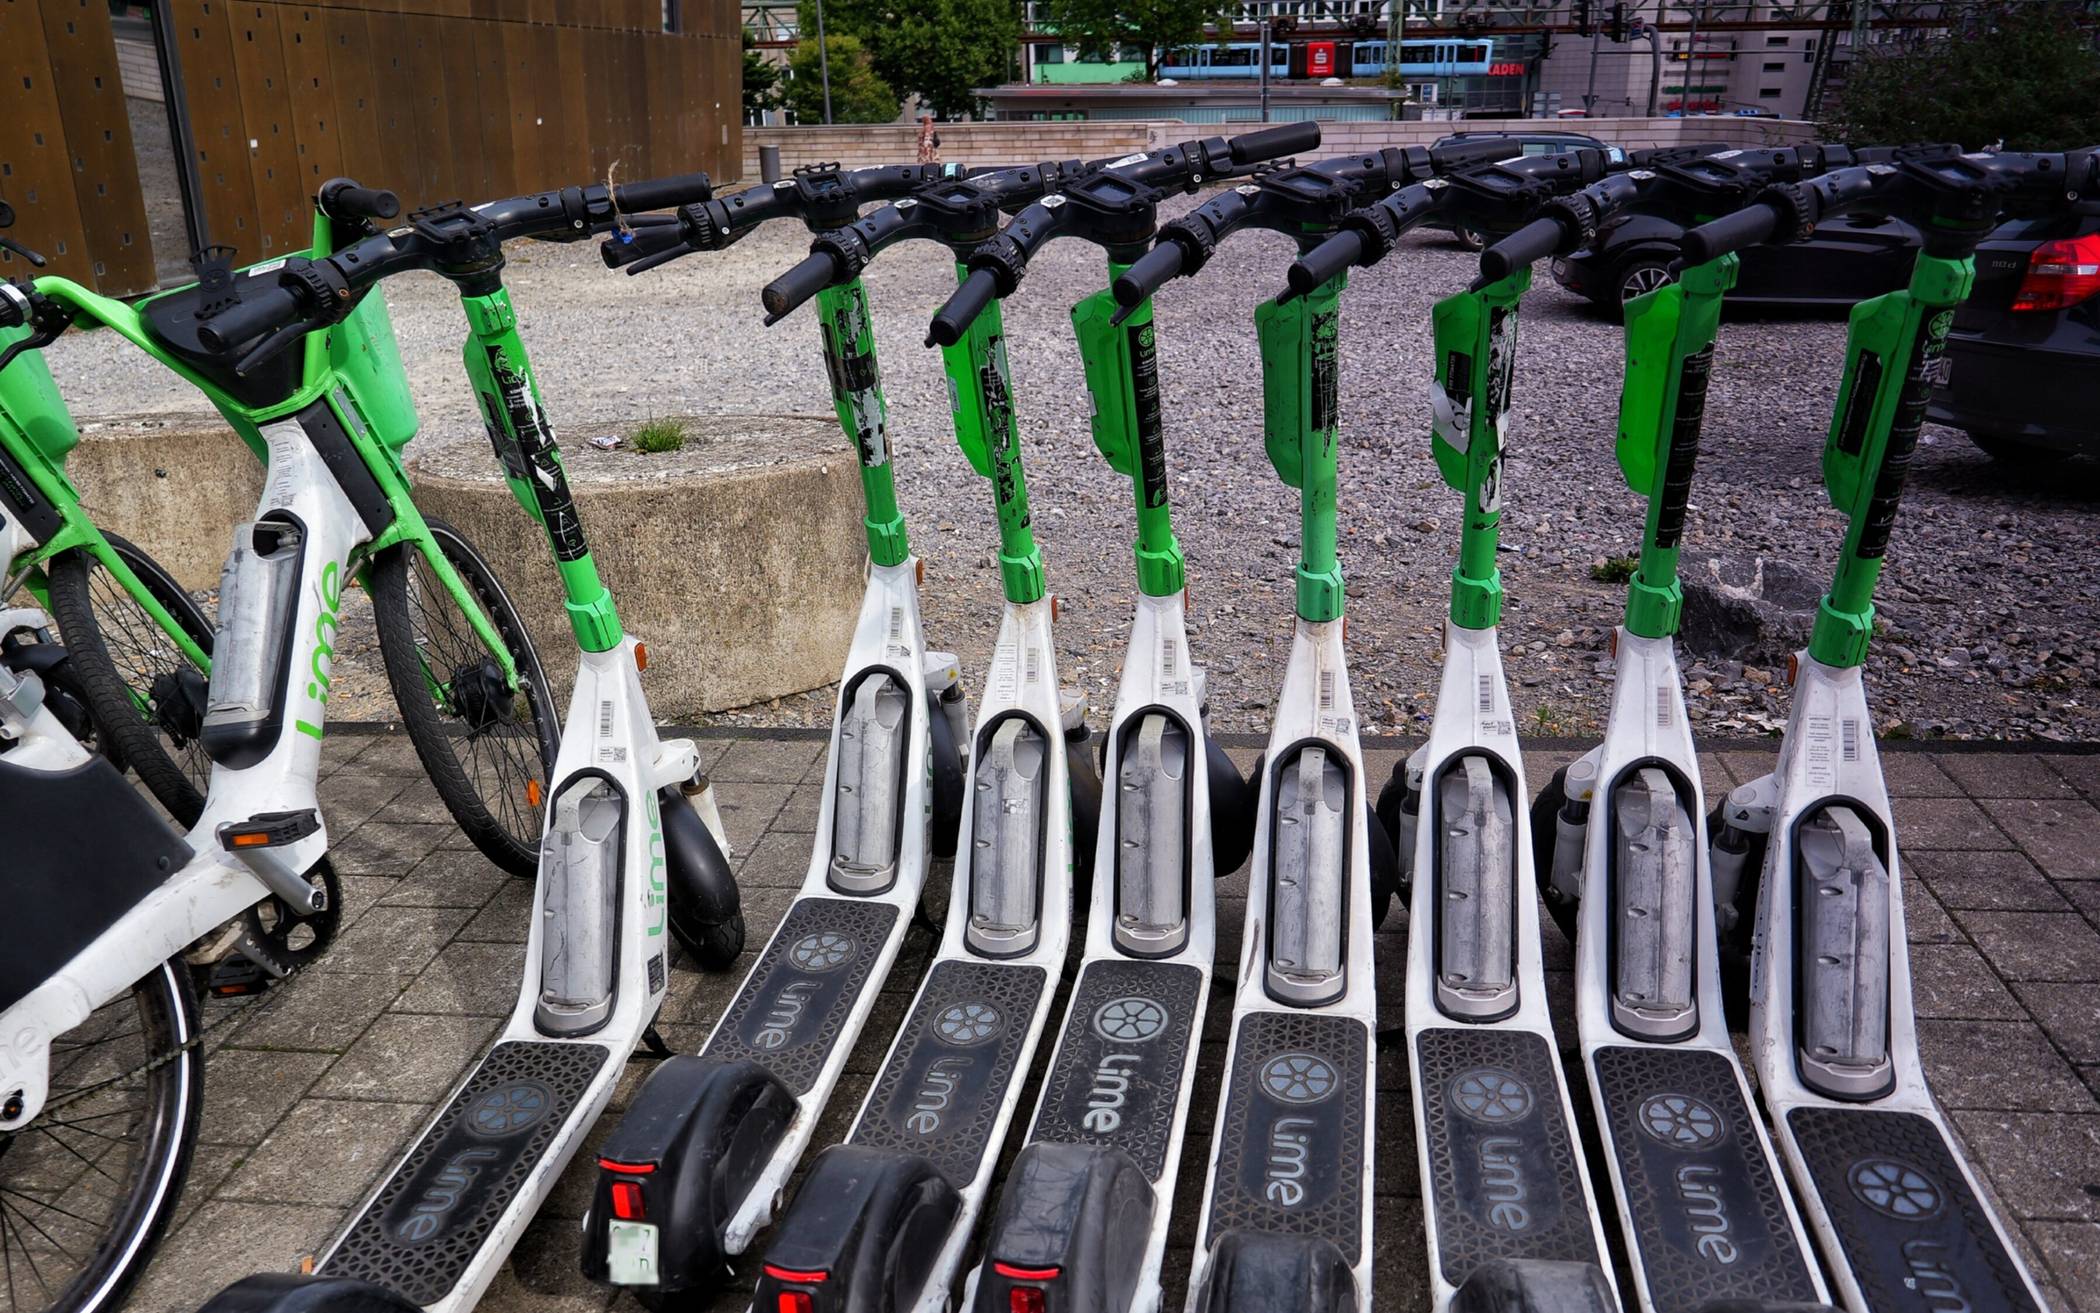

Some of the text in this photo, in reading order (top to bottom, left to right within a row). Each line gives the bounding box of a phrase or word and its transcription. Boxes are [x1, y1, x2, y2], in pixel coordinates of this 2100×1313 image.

[296, 560, 341, 741] Lime
[645, 789, 664, 937] Lime
[754, 981, 821, 1050] Lime
[907, 1057, 973, 1135] Lime
[1083, 1054, 1142, 1134] Lime
[399, 1150, 497, 1243] Lime
[1266, 1117, 1315, 1207] Lime
[1480, 1137, 1530, 1231] Lime
[1677, 1166, 1738, 1265] Lime
[1903, 1240, 1972, 1313] Lim
